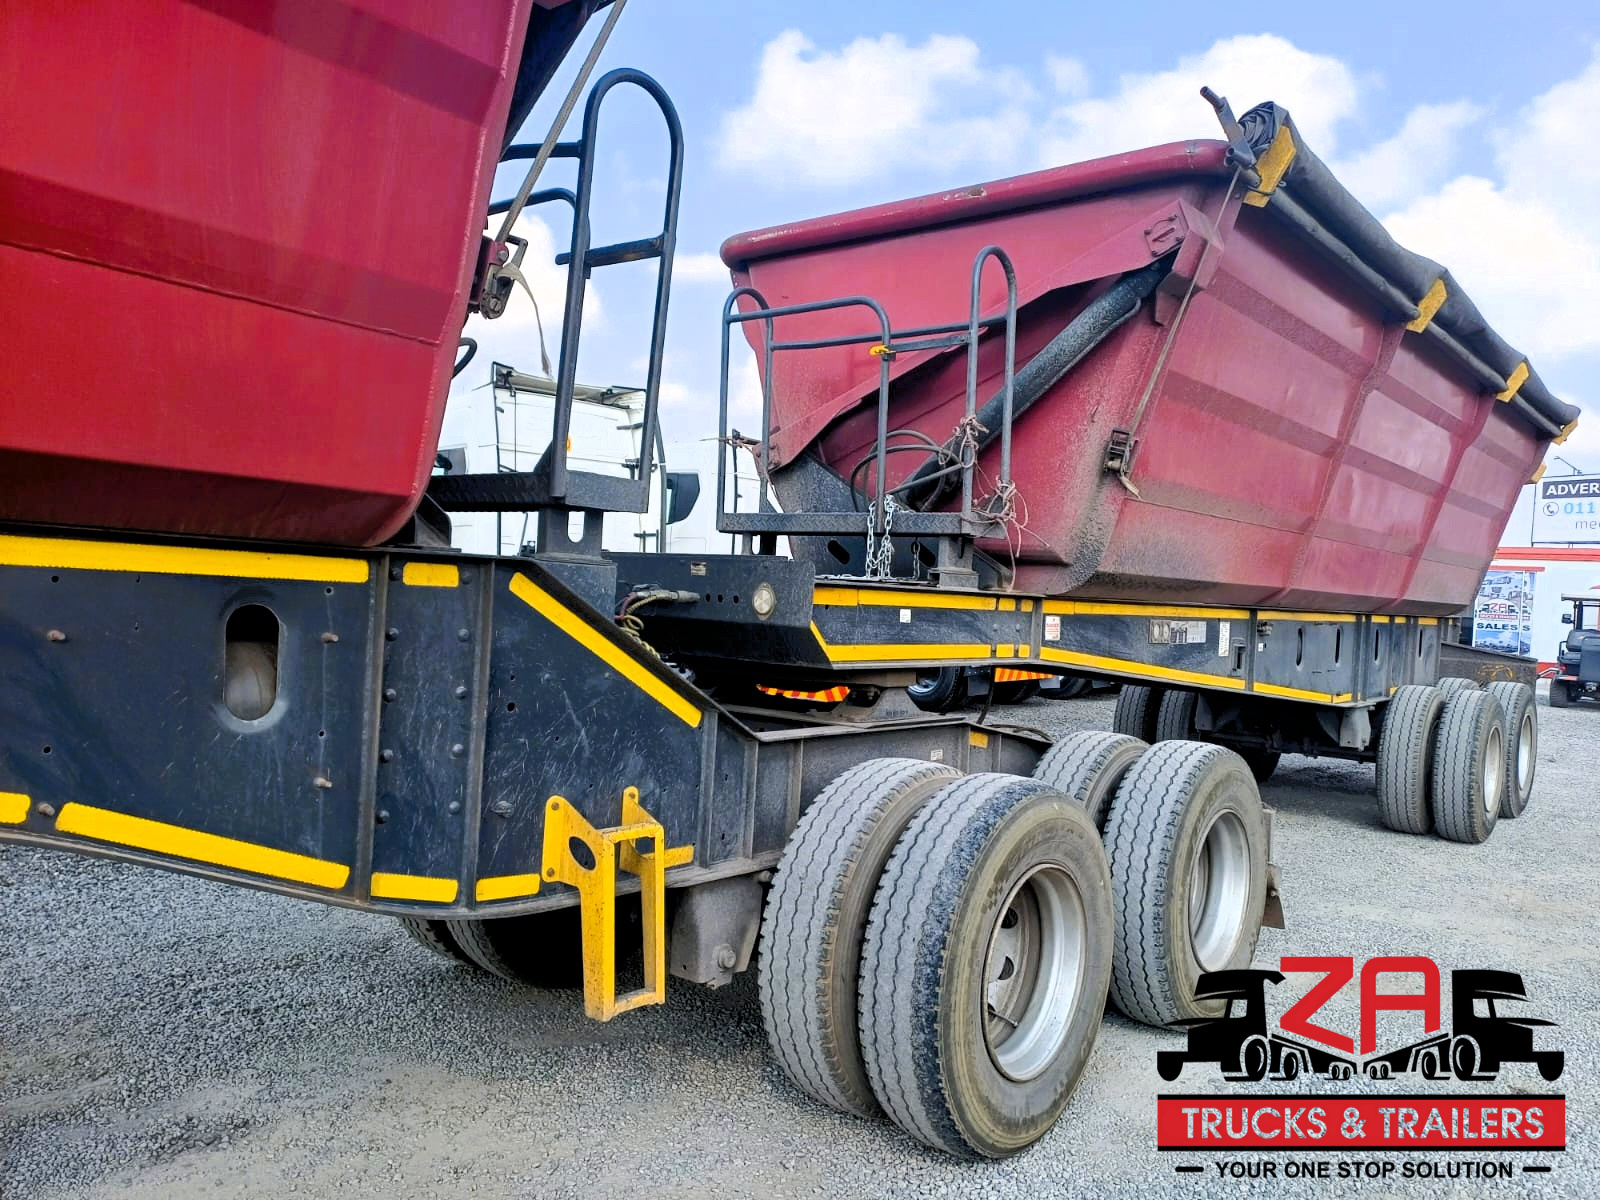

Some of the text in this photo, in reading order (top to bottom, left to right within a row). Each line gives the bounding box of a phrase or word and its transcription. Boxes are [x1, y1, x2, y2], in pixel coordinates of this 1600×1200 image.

[1564, 502, 1595, 514] 011
[1575, 520, 1600, 530] me
[1476, 622, 1518, 631] SALES
